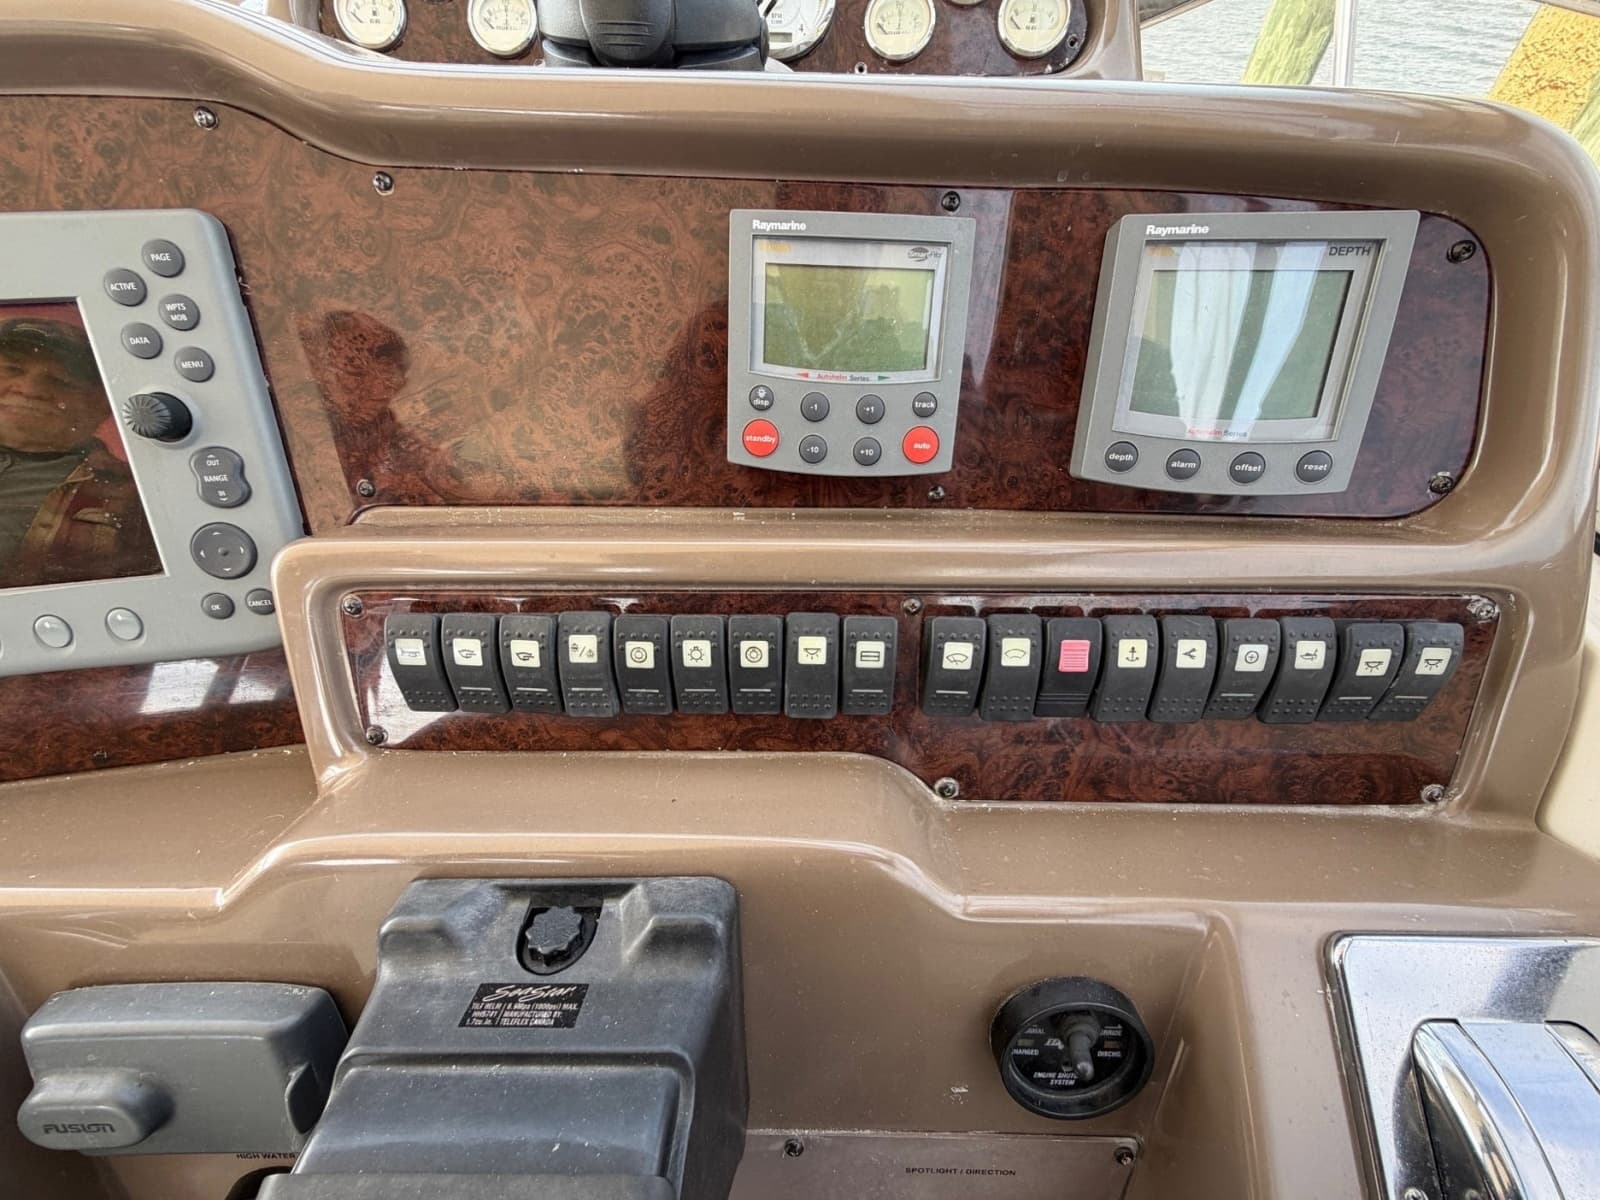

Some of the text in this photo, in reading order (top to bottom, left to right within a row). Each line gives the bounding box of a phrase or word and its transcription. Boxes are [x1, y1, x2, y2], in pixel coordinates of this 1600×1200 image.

[752, 219, 807, 232] Raymarine
[1146, 224, 1210, 237] Raymarine
[1328, 245, 1371, 257] DEPTH
[150, 252, 172, 262] PAGE
[110, 281, 137, 291] ACTIVE
[165, 303, 186, 312] WPTS
[170, 314, 188, 322] MOB
[129, 336, 151, 345] DATA
[181, 360, 204, 369] MENU
[816, 373, 870, 383] Autohelm Series
[753, 398, 770, 407] disp
[915, 400, 936, 409] track
[745, 434, 776, 445] standby
[807, 446, 820, 454] -10
[913, 442, 931, 450] auto
[1108, 451, 1134, 463] depth
[206, 459, 220, 467] OUT
[1171, 459, 1196, 469] alarm
[1234, 461, 1262, 473] offset
[1303, 462, 1328, 472] reset
[203, 475, 229, 483] RANGE
[248, 599, 273, 607] CANCEL
[43, 1122, 116, 1135] FUSION
[261, 1152, 296, 1160] WATER
[905, 1167, 957, 1175] SPOTLIGHT
[965, 1168, 1017, 1176] DIRECTION
